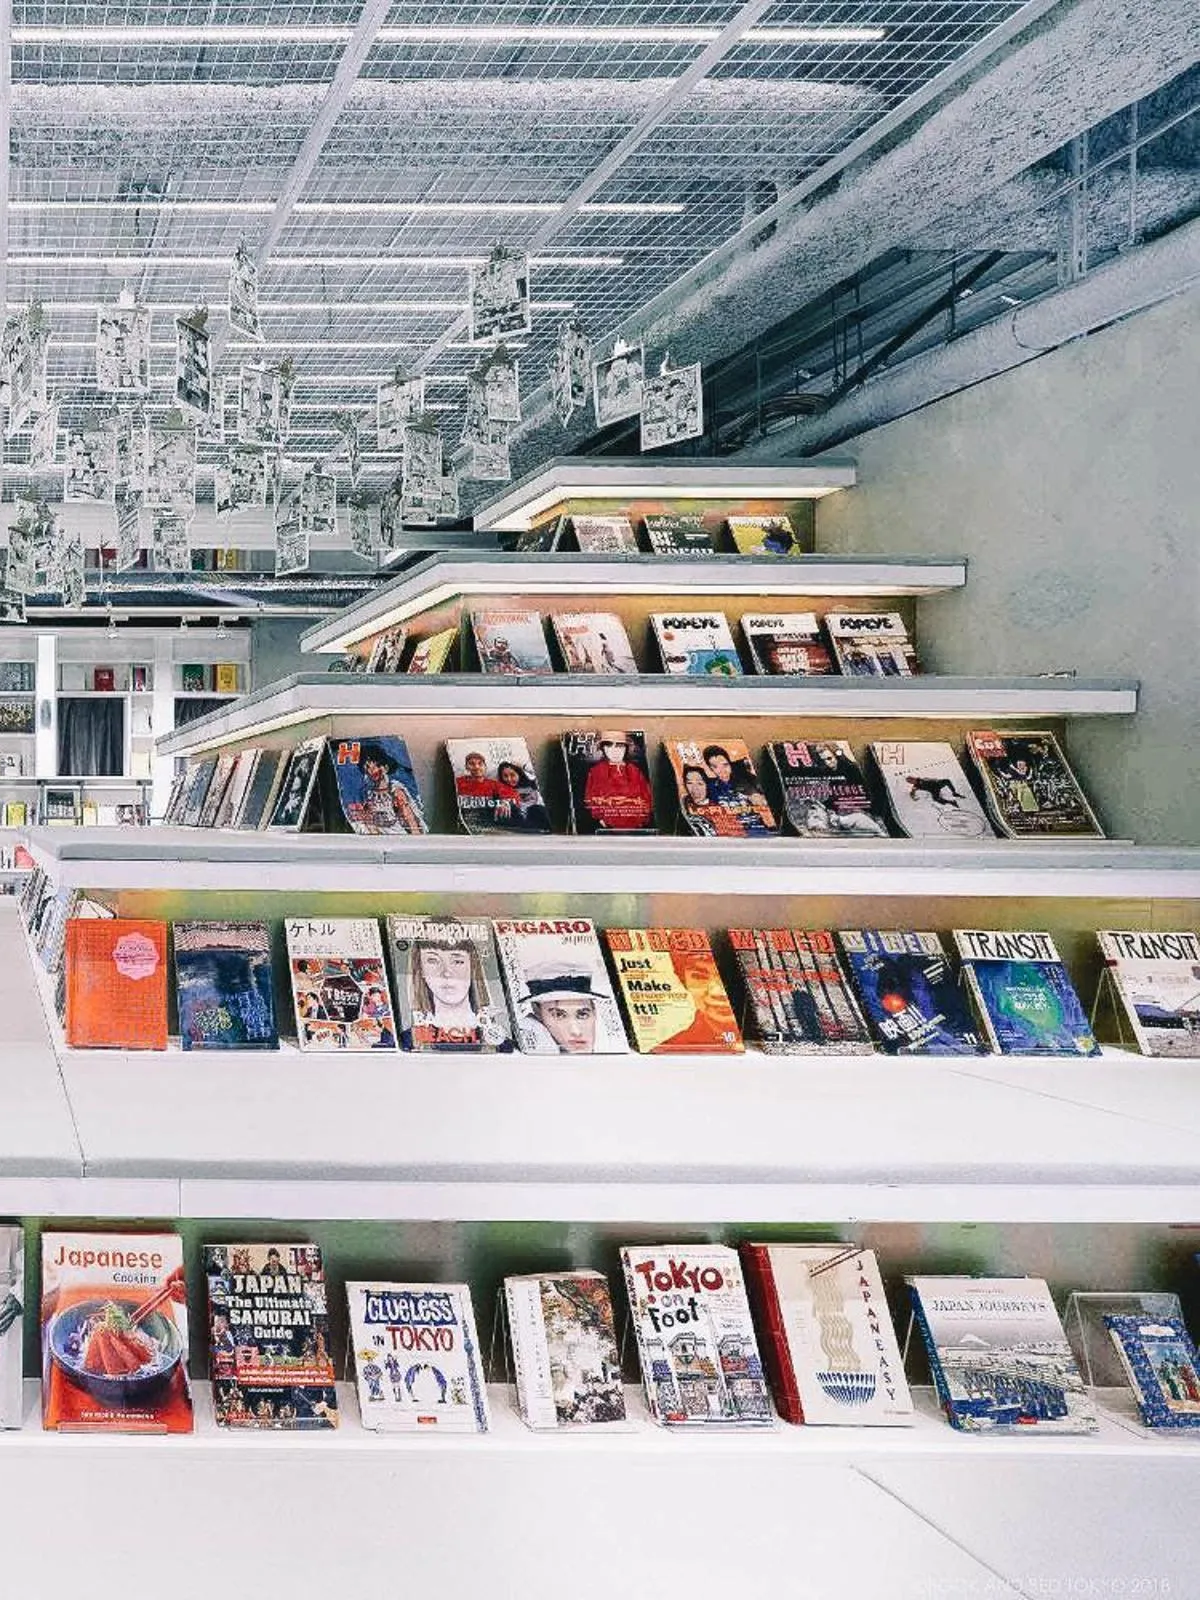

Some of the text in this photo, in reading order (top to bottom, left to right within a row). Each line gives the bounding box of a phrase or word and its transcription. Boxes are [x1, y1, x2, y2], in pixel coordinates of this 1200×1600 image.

[839, 618, 893, 630] POPEYE
[337, 742, 361, 765] H
[784, 742, 813, 767] H
[881, 743, 905, 765] H
[289, 922, 336, 938] ケトル
[495, 921, 591, 934] FIGARO
[963, 932, 1053, 960] TRANSIT
[1108, 932, 1199, 960] TRANSIT
[620, 958, 652, 973] Just
[627, 980, 671, 991] Make
[54, 1246, 163, 1268] Japanese
[113, 1272, 157, 1285] Cooking
[233, 1275, 303, 1294] JAPAN
[226, 1297, 313, 1310] The Ultimate
[230, 1310, 311, 1326] SAMURAI
[647, 1297, 700, 1333] Foot
[254, 1326, 294, 1340] Guide
[386, 1326, 454, 1351] TOKYO
